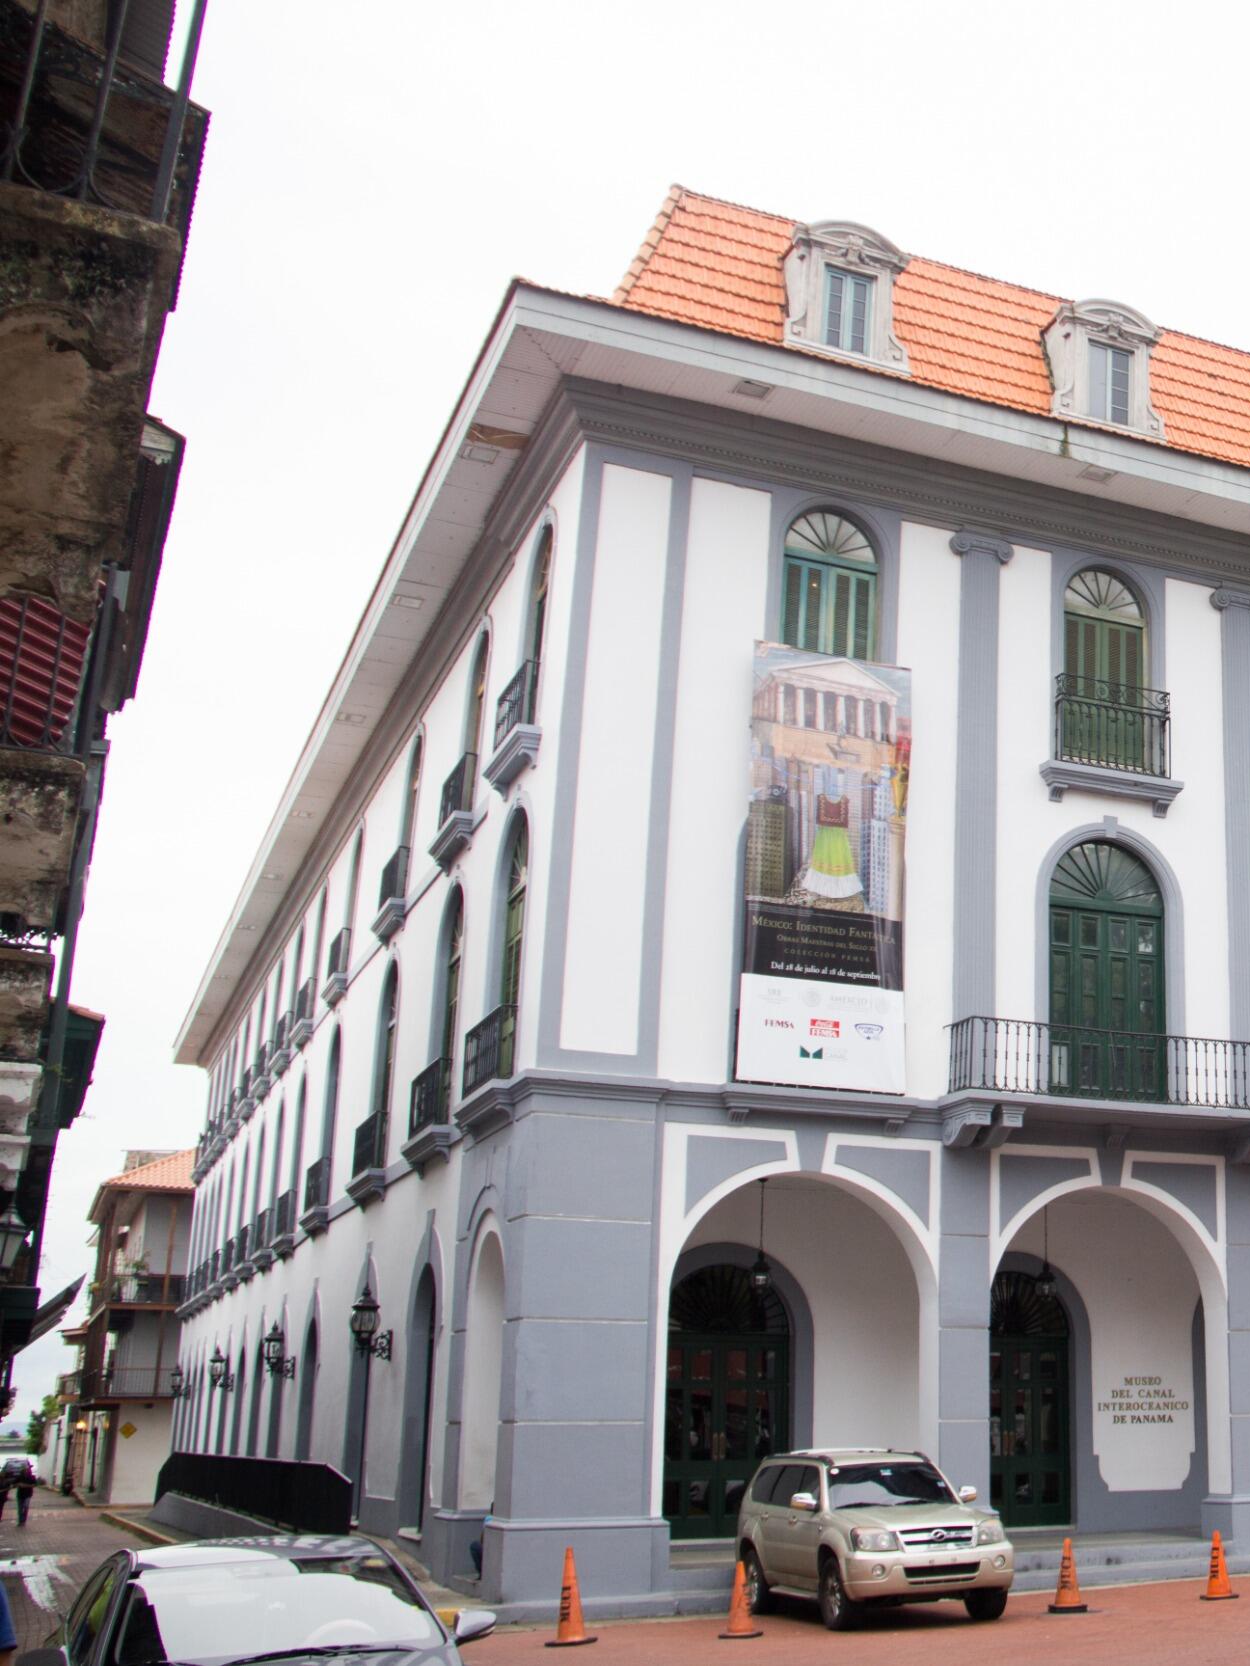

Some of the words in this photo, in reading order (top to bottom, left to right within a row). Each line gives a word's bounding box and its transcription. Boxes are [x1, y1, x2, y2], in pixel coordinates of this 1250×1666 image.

[797, 920, 846, 936] IDENTIDAD
[771, 961, 784, 970] Del
[794, 963, 803, 972] de
[804, 964, 820, 974] julio
[821, 966, 828, 975] al
[837, 968, 846, 977] de
[1124, 1376, 1162, 1386] MUSEO
[1111, 1389, 1133, 1399] DEL
[1138, 1389, 1176, 1399] CANAL
[1097, 1401, 1189, 1412] INTEROCEANICO
[1112, 1415, 1127, 1424] DE
[1130, 1414, 1174, 1424] PANAMA
[1209, 1545, 1220, 1580] MUCI
[1060, 1555, 1072, 1591] MUCI
[559, 1584, 571, 1623] MUCI
